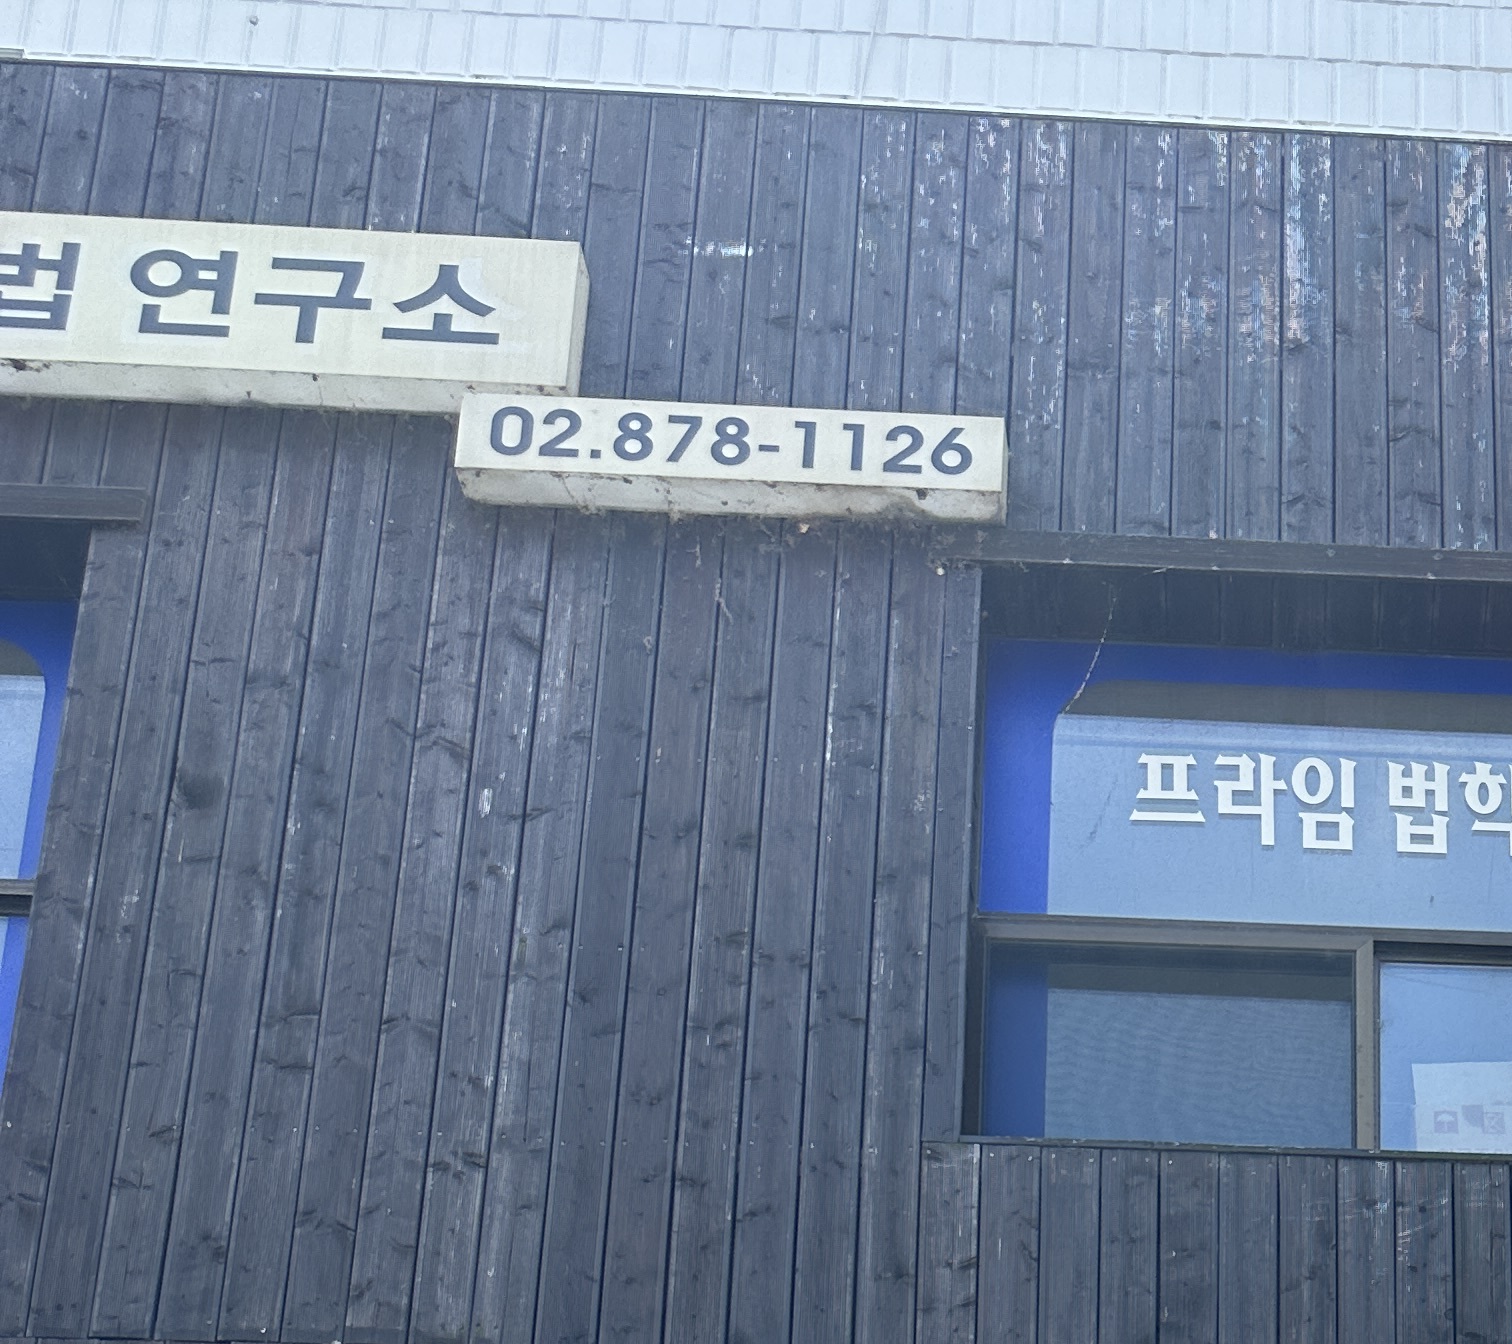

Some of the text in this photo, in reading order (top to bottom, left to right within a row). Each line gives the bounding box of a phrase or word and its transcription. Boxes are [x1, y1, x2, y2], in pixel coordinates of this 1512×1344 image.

[130, 249, 499, 345] 연구소
[490, 407, 974, 477] 02.878-1126
[1129, 752, 1356, 850] 프라임
